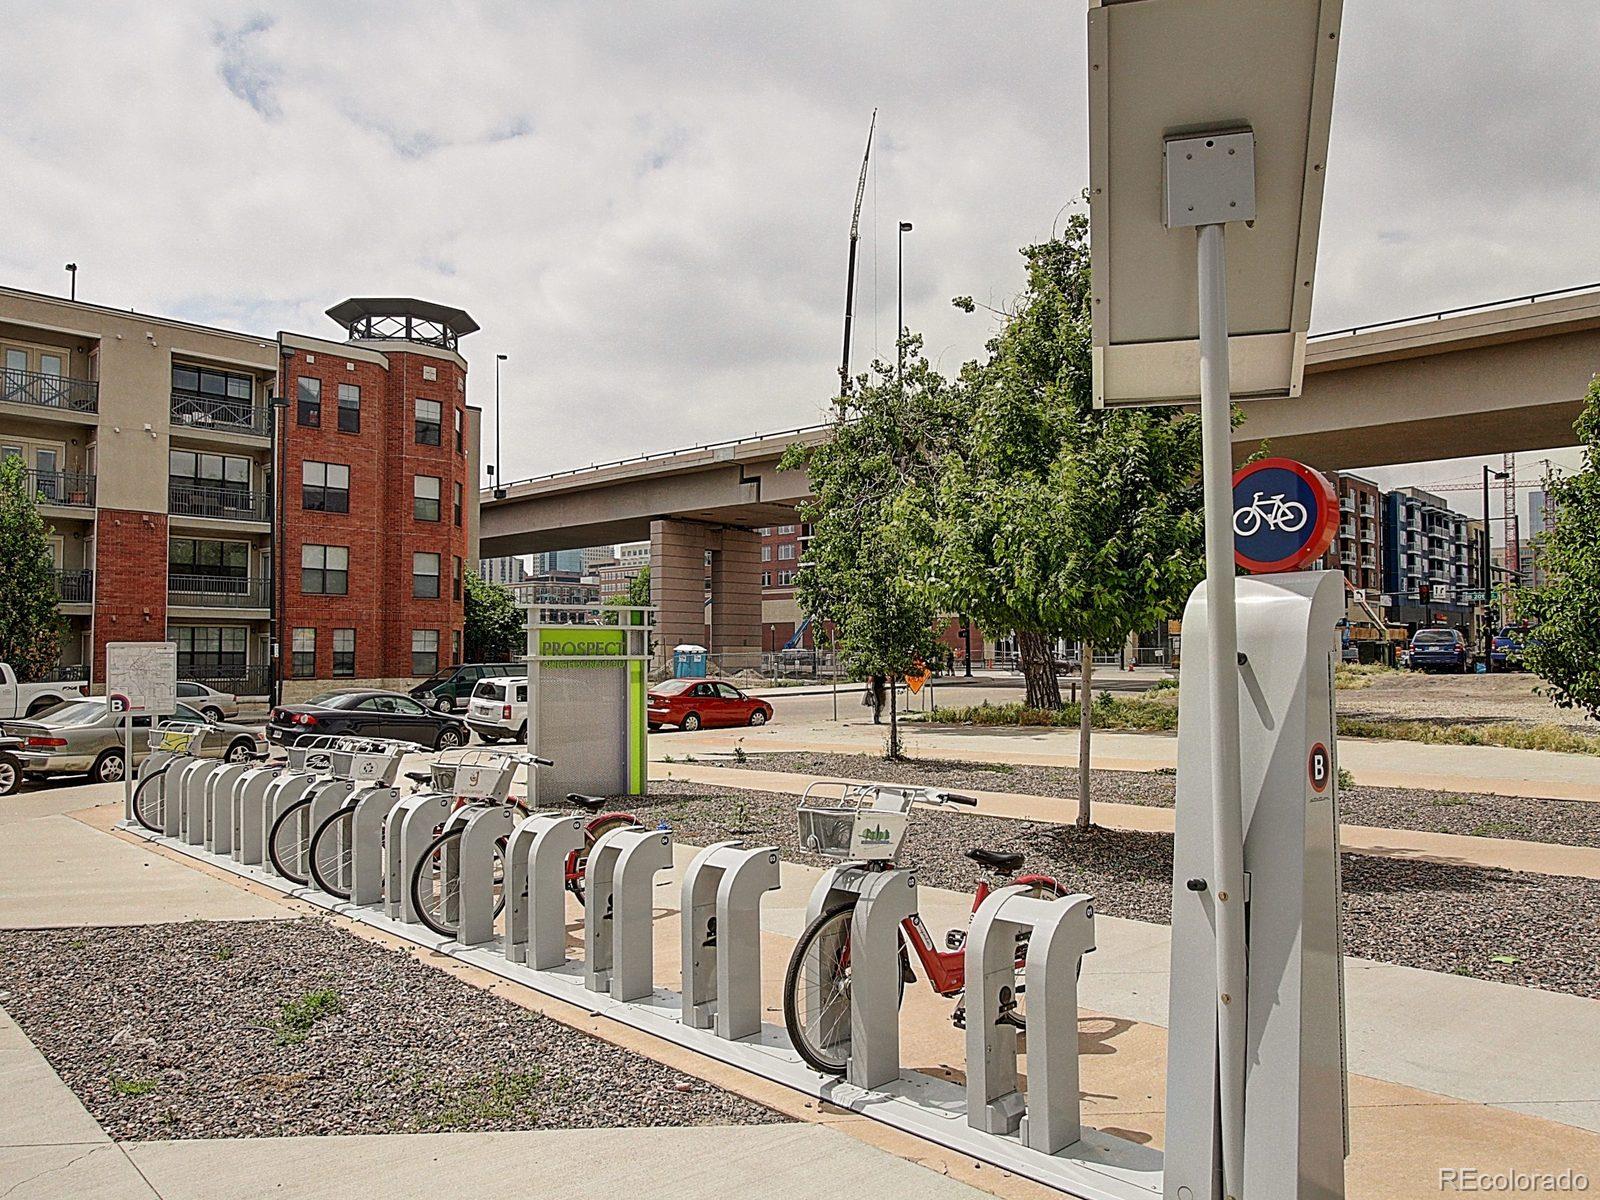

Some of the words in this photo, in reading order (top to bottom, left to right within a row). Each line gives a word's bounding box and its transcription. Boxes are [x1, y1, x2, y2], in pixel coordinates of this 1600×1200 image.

[542, 641, 623, 656] PROSPECT
[111, 700, 123, 712] B
[1314, 755, 1324, 780] B
